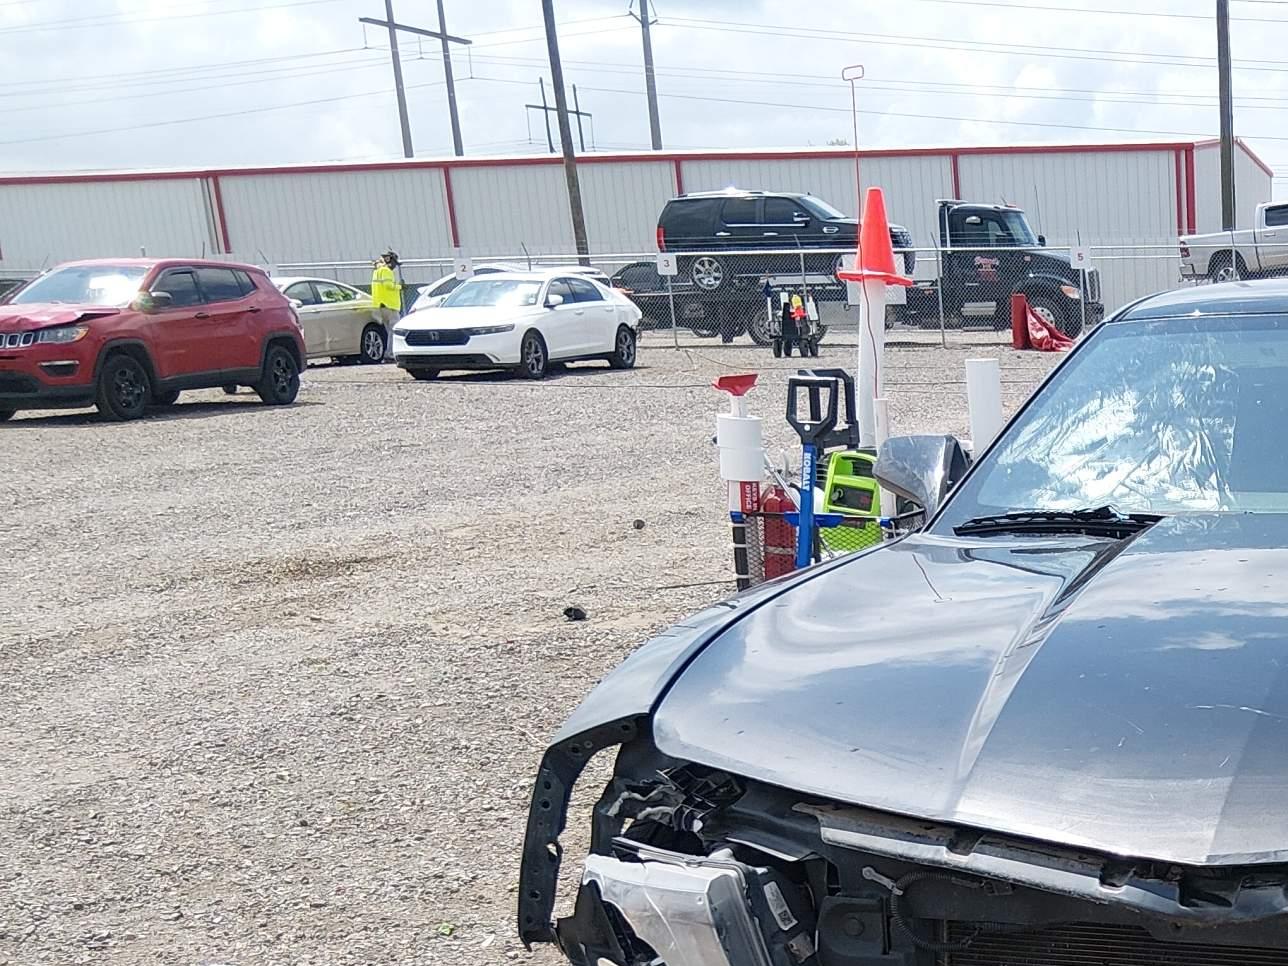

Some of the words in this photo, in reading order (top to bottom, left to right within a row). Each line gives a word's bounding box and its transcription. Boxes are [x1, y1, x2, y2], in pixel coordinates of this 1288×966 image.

[1077, 252, 1084, 261] 5
[663, 259, 670, 268] 3
[802, 452, 812, 491] KOBALT
